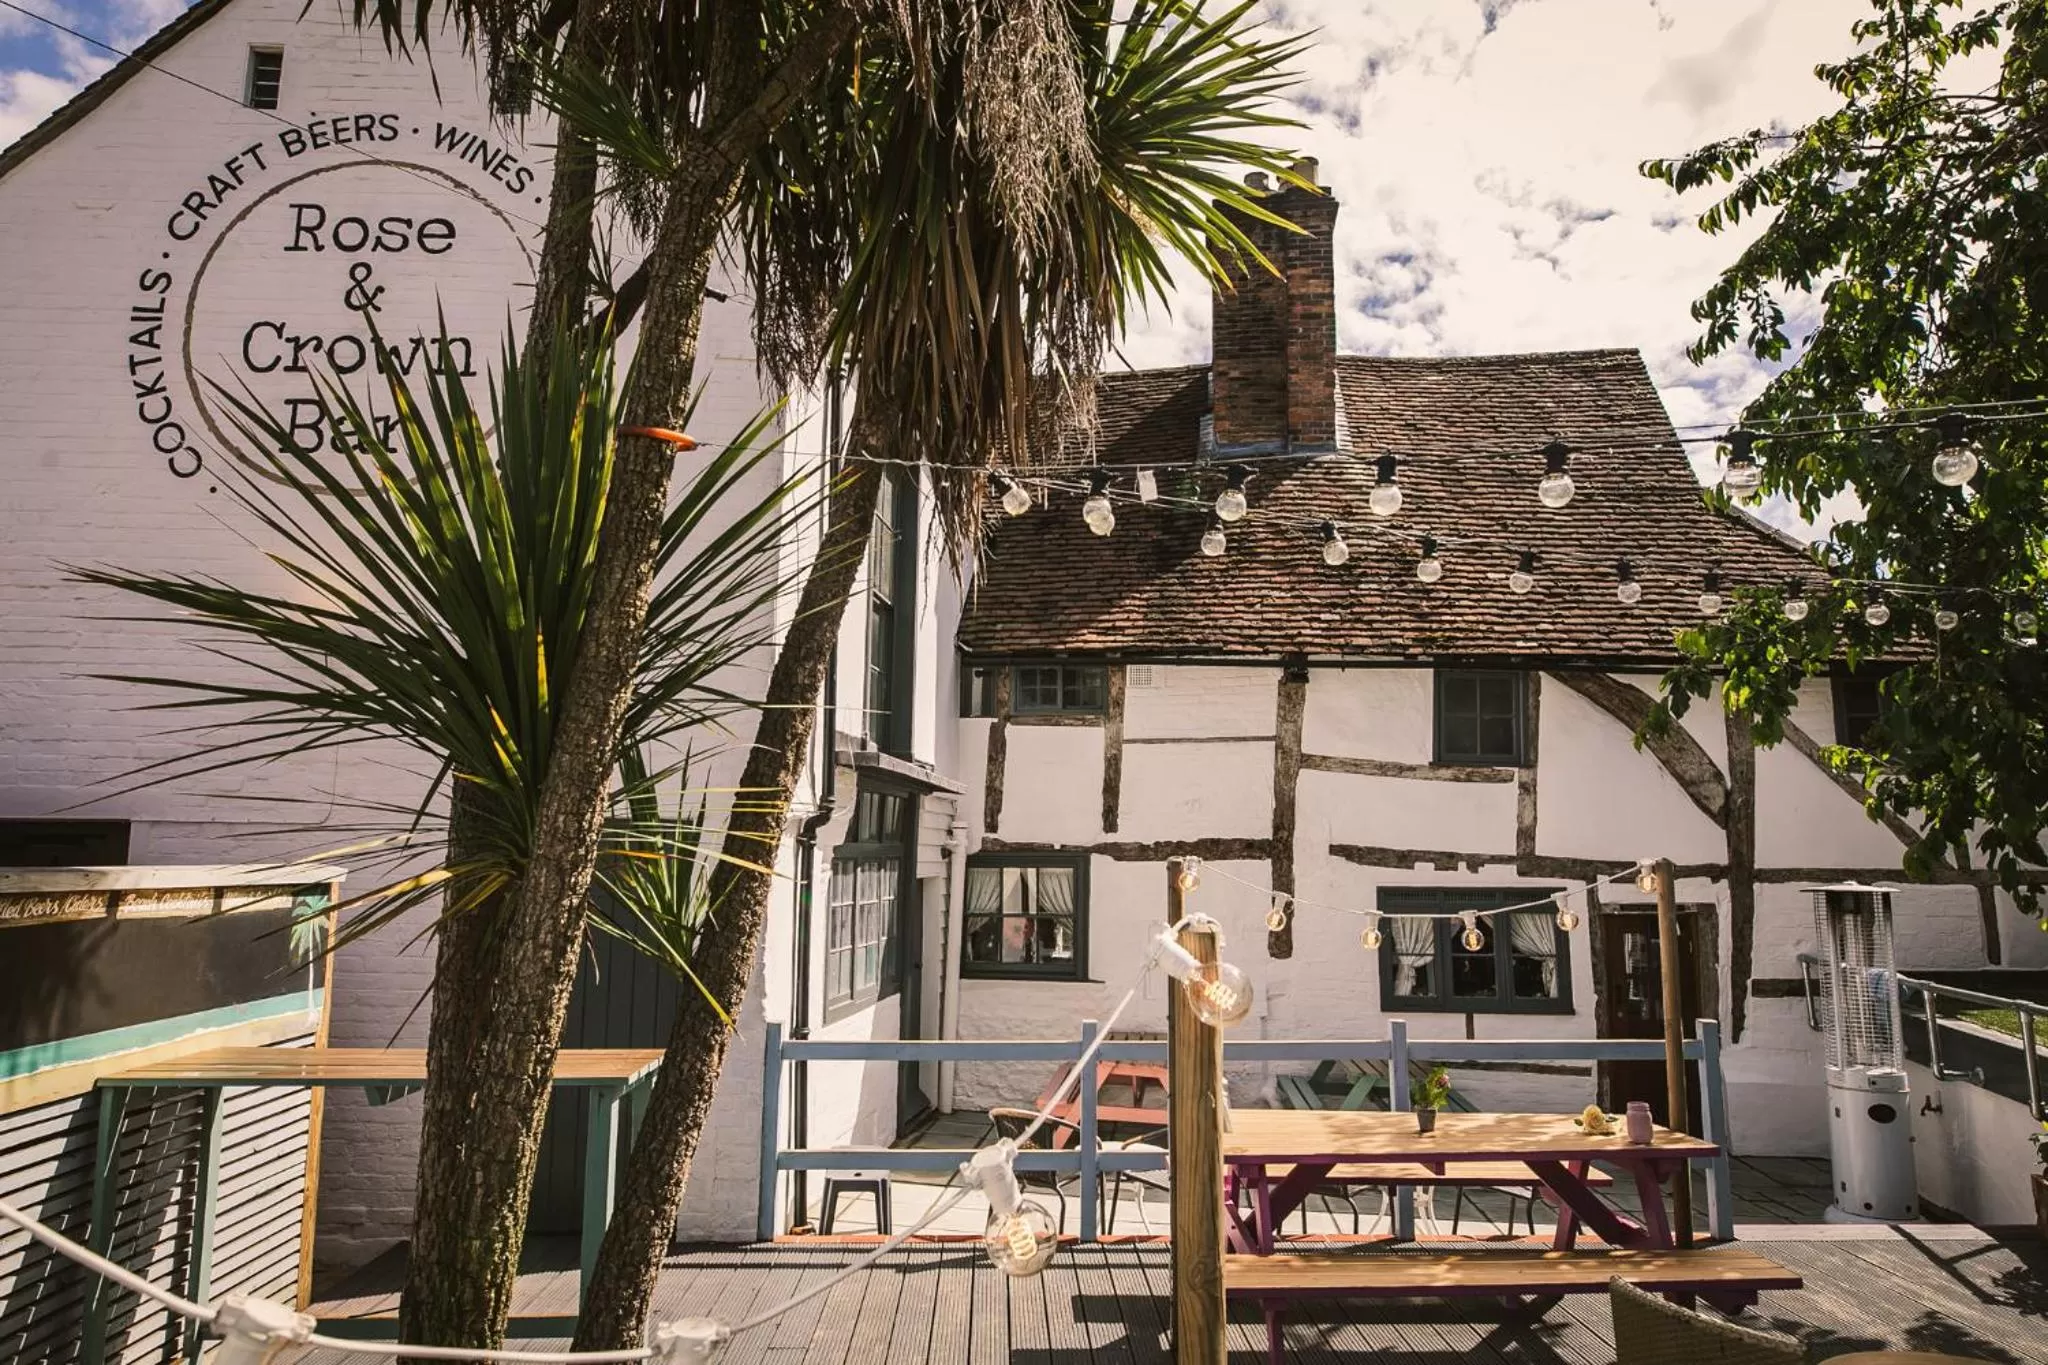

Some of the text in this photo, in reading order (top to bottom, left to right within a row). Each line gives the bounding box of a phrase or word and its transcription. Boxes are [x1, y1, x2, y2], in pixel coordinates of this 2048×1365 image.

[283, 203, 456, 254] Rose
[129, 114, 534, 478] COCKTAILS CRAFT BEERS WINES
[344, 261, 385, 312] &
[243, 321, 477, 376] Crown
[279, 398, 401, 454] Bar
